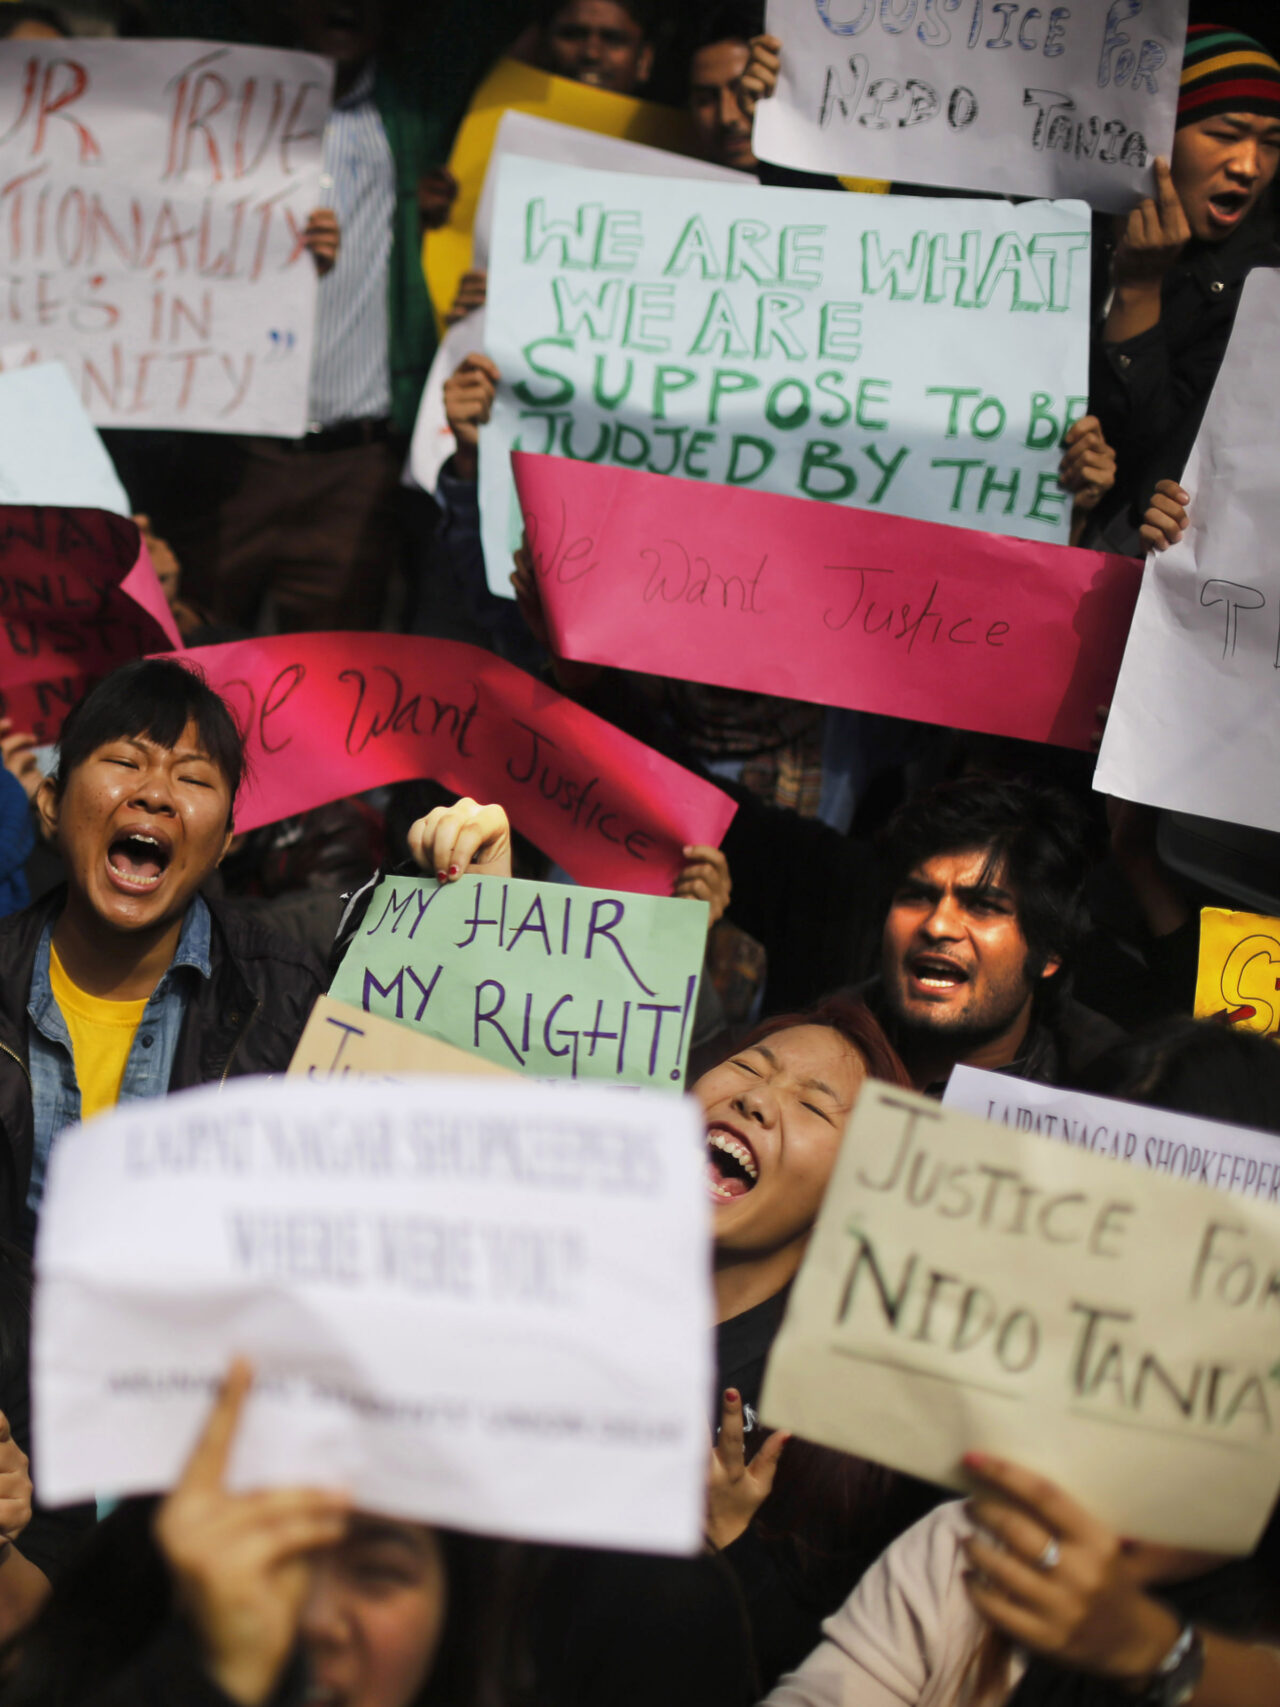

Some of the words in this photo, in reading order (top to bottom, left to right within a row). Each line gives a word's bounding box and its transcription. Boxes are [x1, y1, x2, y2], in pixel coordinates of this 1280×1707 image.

[523, 197, 644, 272] WE
[662, 212, 827, 290] ARE
[861, 229, 1091, 315] WHAT
[552, 276, 676, 353] WE
[688, 287, 863, 364] ARE
[511, 336, 892, 433] SUPPOSE
[925, 386, 1007, 442] TO
[797, 439, 911, 505] BY
[930, 458, 1067, 526] THE
[524, 498, 599, 584] We
[639, 538, 768, 614] Want
[822, 564, 1011, 656] Justice
[338, 664, 480, 757] Want
[367, 884, 447, 941] MY
[455, 882, 658, 998] HAIR
[362, 965, 444, 1021] MY
[473, 974, 698, 1083] RIGHT!
[854, 1094, 1137, 1258] JUSTICE
